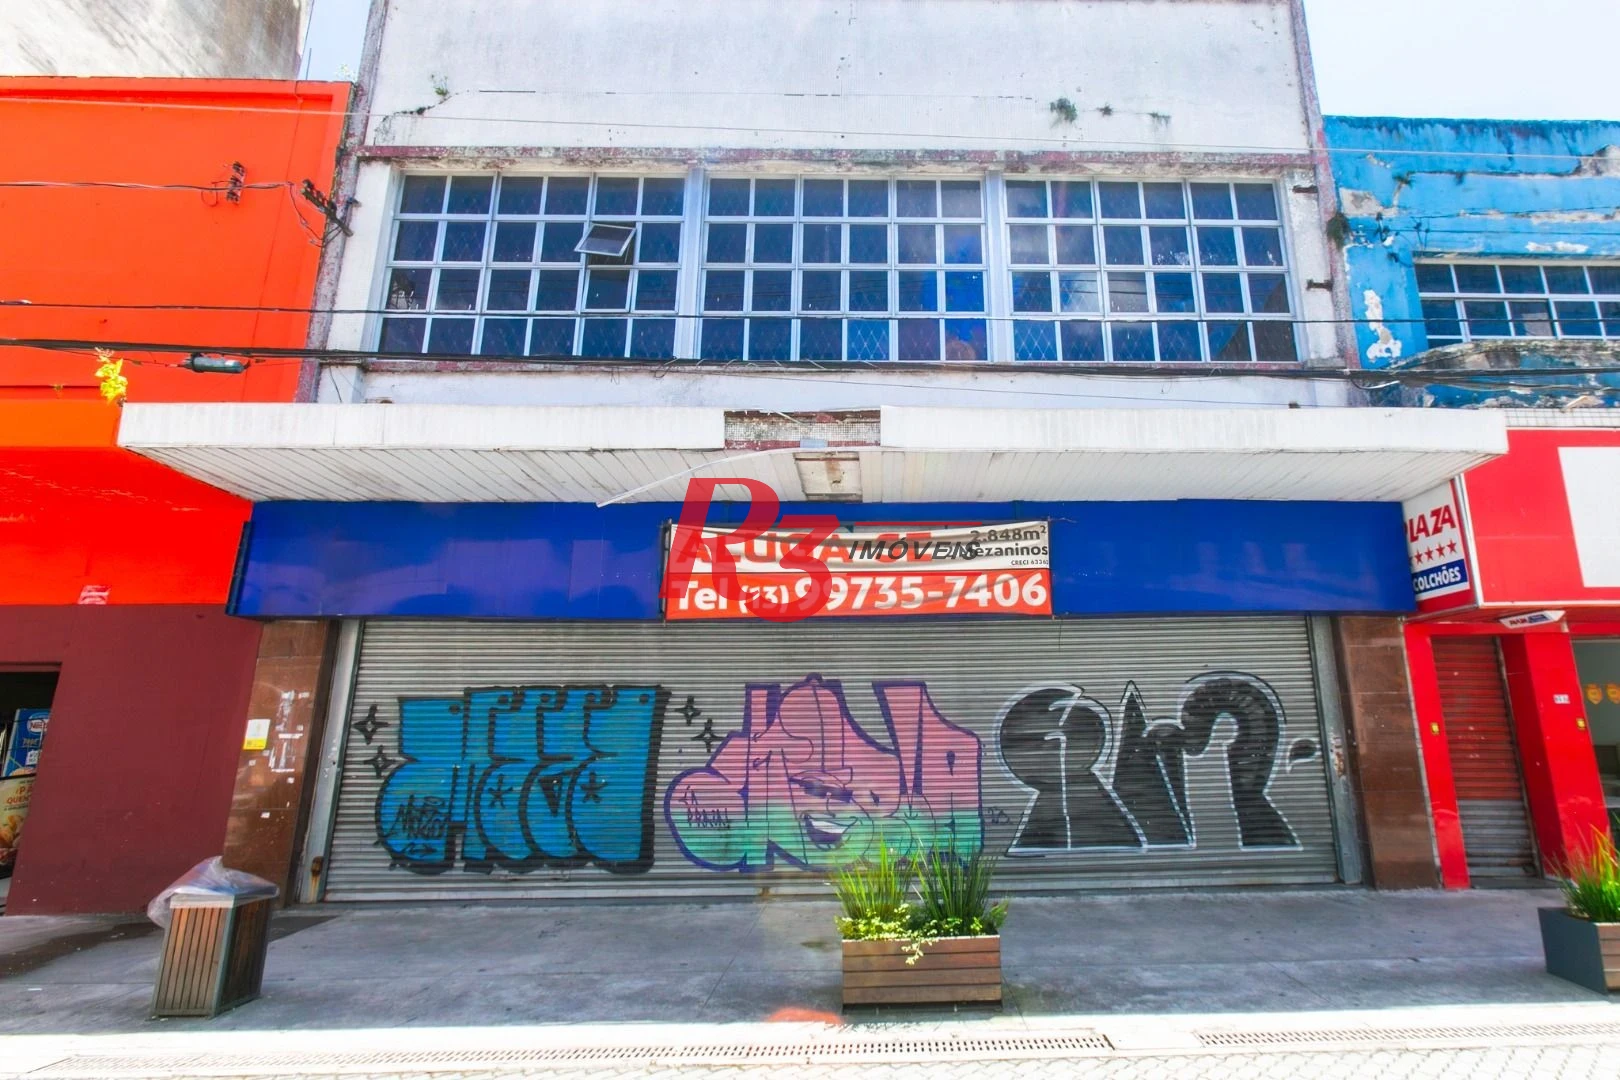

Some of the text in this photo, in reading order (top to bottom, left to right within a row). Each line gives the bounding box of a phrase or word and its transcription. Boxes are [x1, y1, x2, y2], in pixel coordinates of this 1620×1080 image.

[1404, 505, 1457, 543] LAZA
[794, 572, 1047, 611] 99735-7406
[1413, 566, 1462, 592] COLCHÕES
